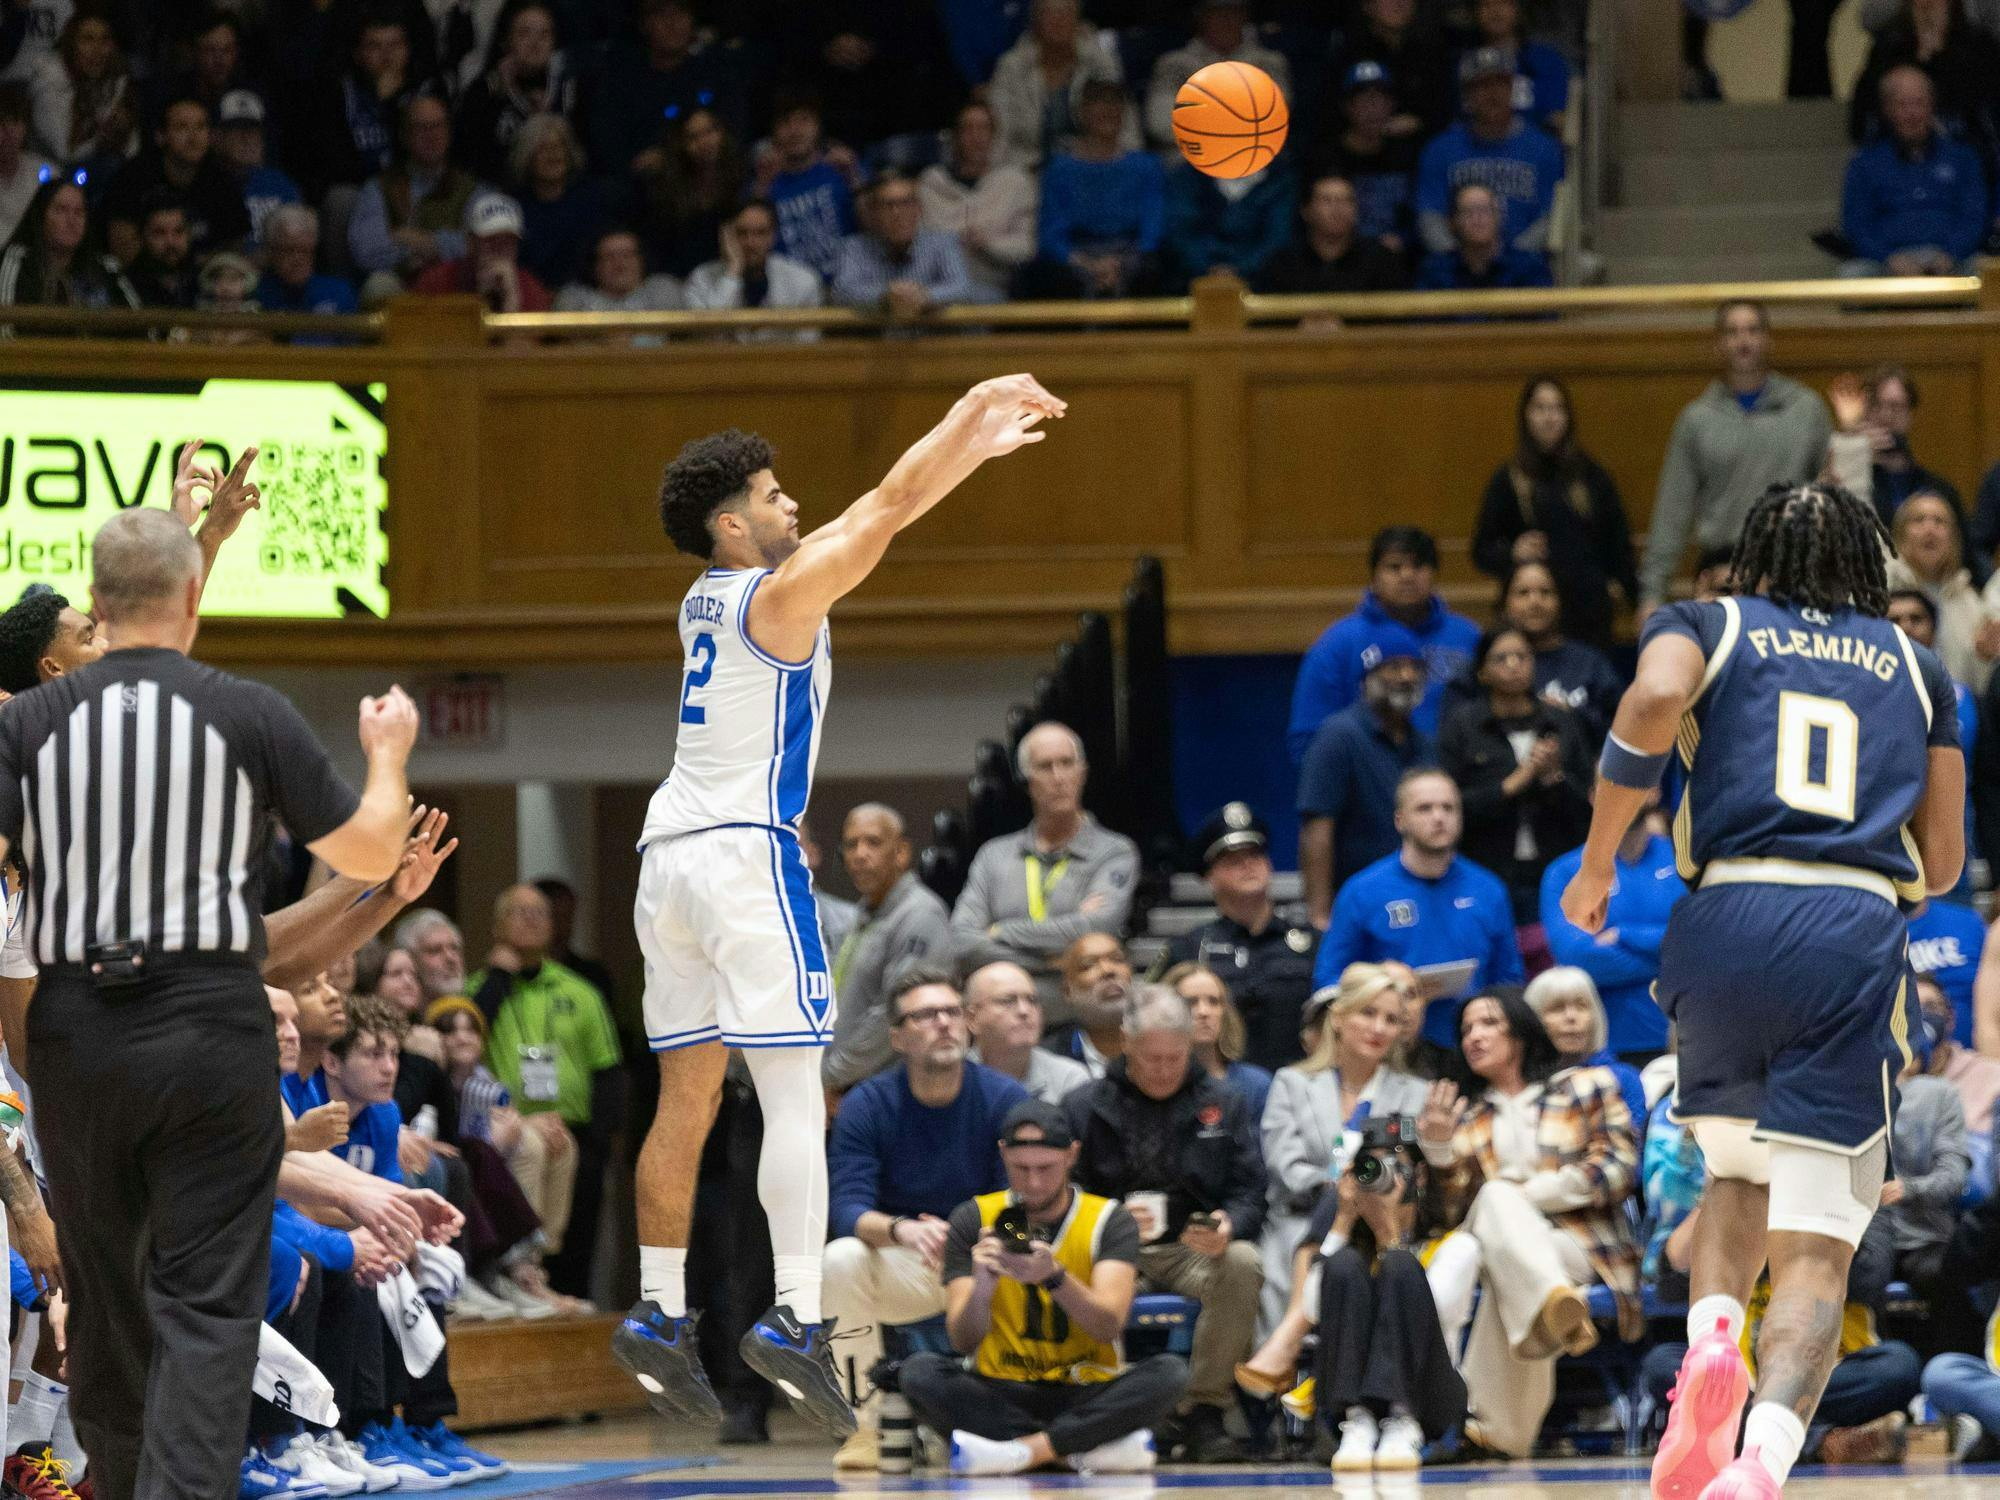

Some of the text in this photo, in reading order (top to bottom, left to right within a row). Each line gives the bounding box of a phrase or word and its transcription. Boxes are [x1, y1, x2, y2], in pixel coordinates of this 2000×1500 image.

[0, 438, 231, 511] ave
[680, 632, 716, 725] 2
[1748, 626, 1899, 682] FLEMING
[1775, 689, 1858, 822] 0
[807, 971, 828, 1000] D
